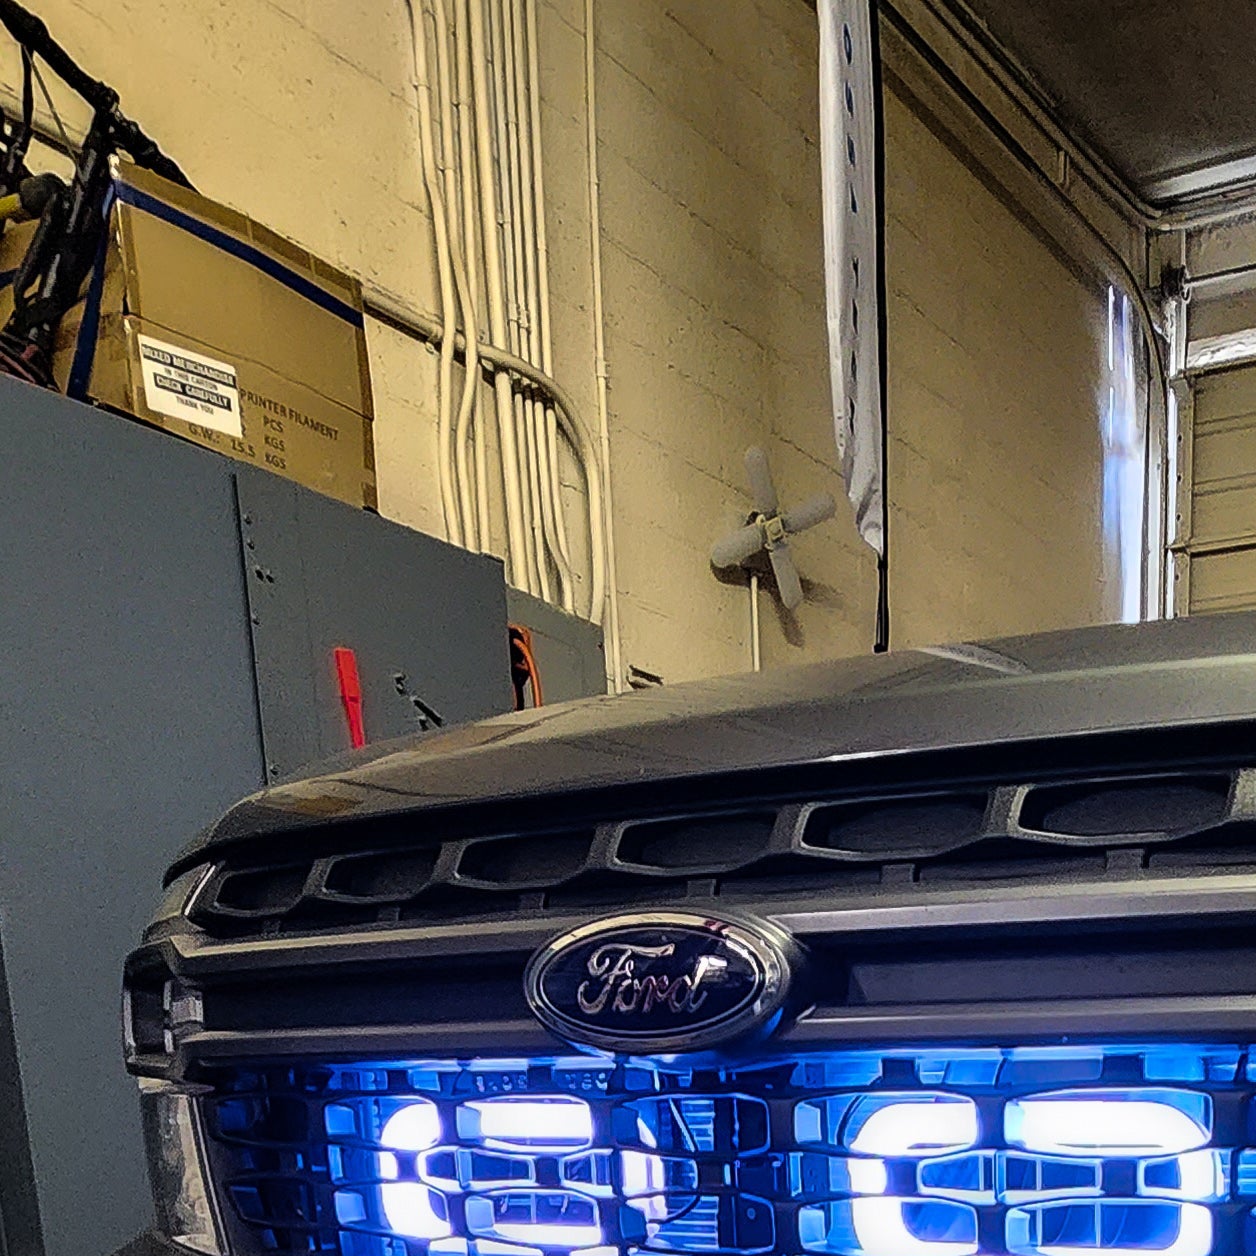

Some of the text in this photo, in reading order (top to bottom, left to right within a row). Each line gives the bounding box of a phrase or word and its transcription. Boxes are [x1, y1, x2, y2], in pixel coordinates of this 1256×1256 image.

[240, 388, 287, 418] PRINTER
[288, 407, 339, 440] FILAMENT
[264, 415, 284, 433] PCS
[264, 434, 285, 452] KGS
[264, 451, 287, 470] KGS
[577, 943, 722, 1014] Ford
